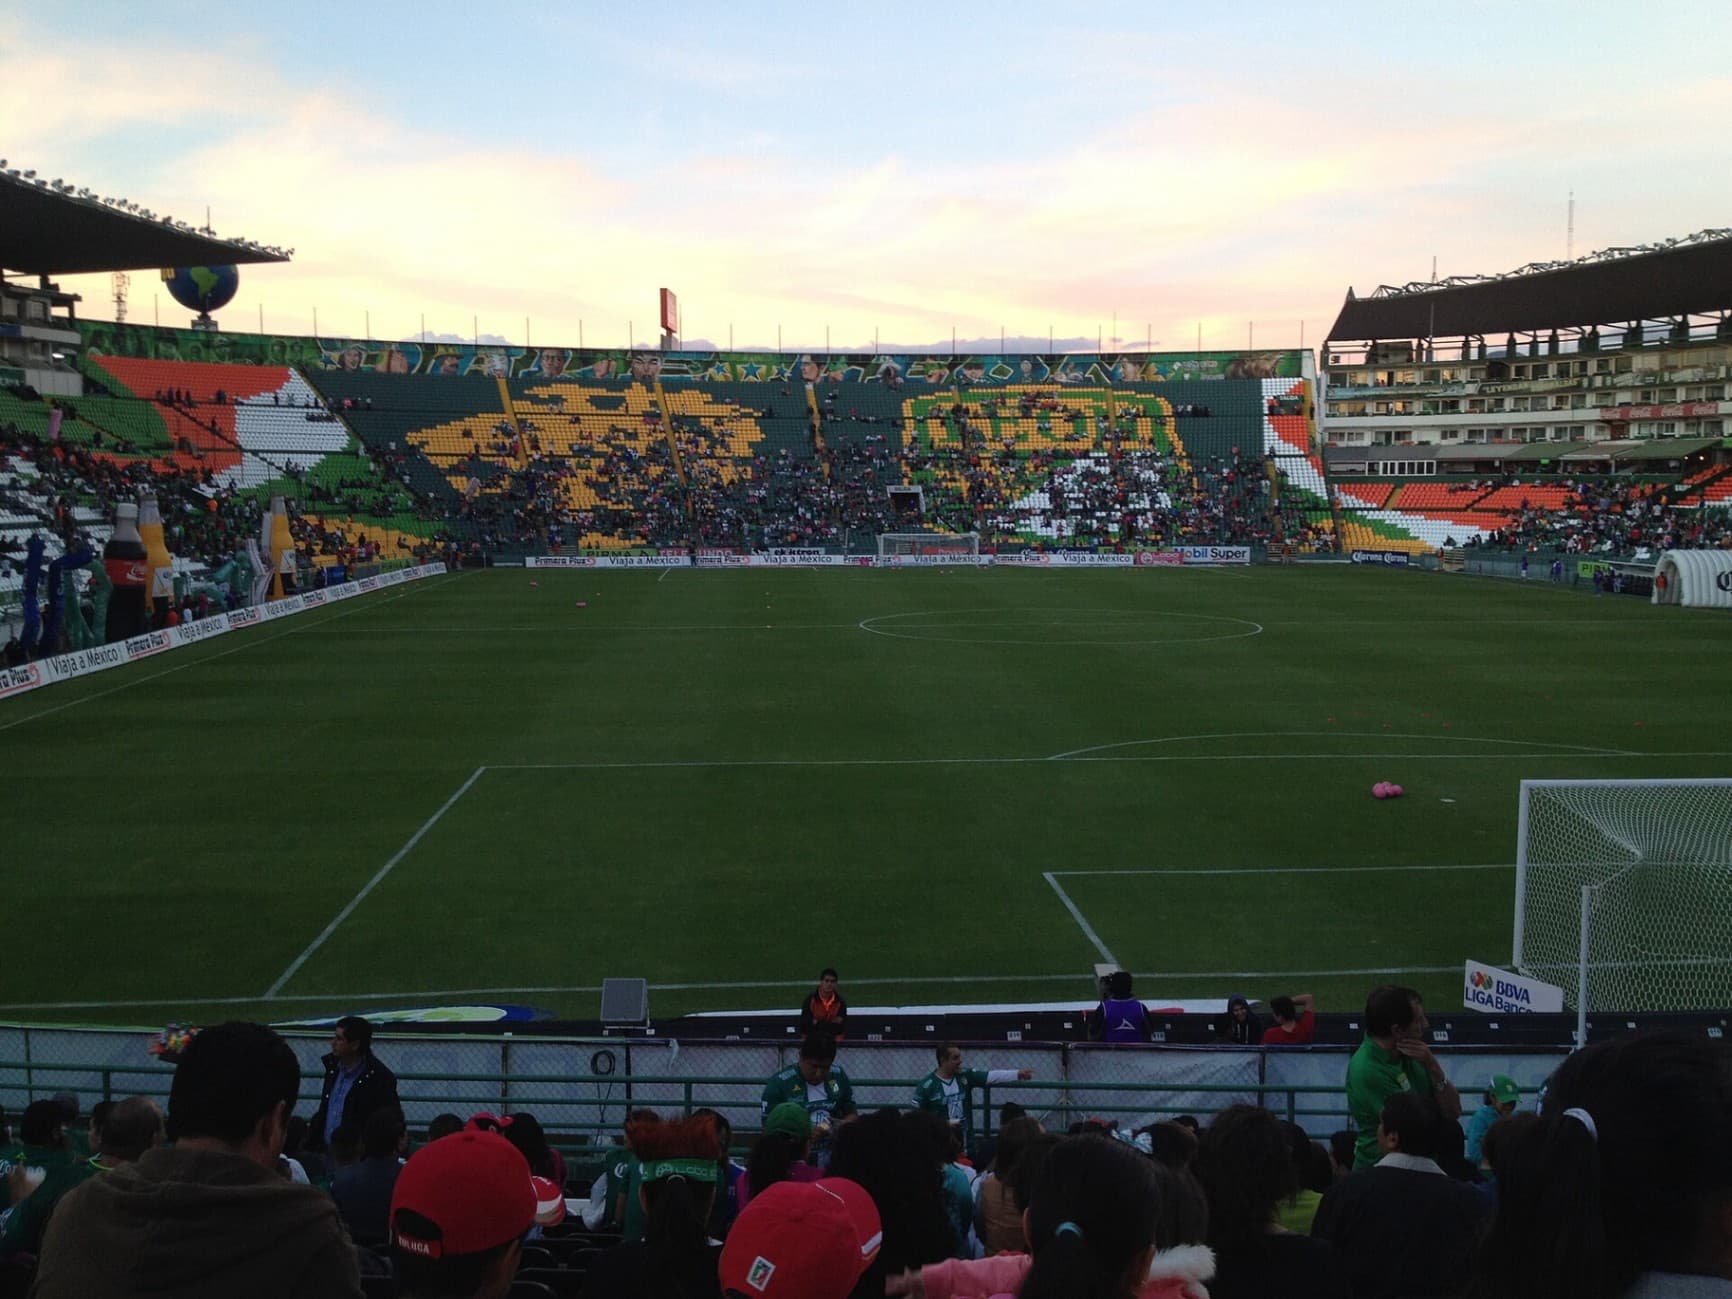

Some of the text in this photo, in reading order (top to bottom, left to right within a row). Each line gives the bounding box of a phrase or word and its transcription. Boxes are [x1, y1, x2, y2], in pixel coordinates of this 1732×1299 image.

[609, 557, 634, 566] Viaja
[763, 555, 787, 565] Viaja
[1062, 553, 1086, 565] Viaja
[1210, 548, 1246, 560] Super
[176, 624, 196, 642] Viaja
[125, 633, 164, 656] Primera Plus
[50, 655, 78, 677] Viaja
[79, 655, 86, 669] a
[8, 668, 31, 686] Plus
[1465, 987, 1537, 1016] LIGA Banco
[1496, 981, 1530, 1005] BBVA
